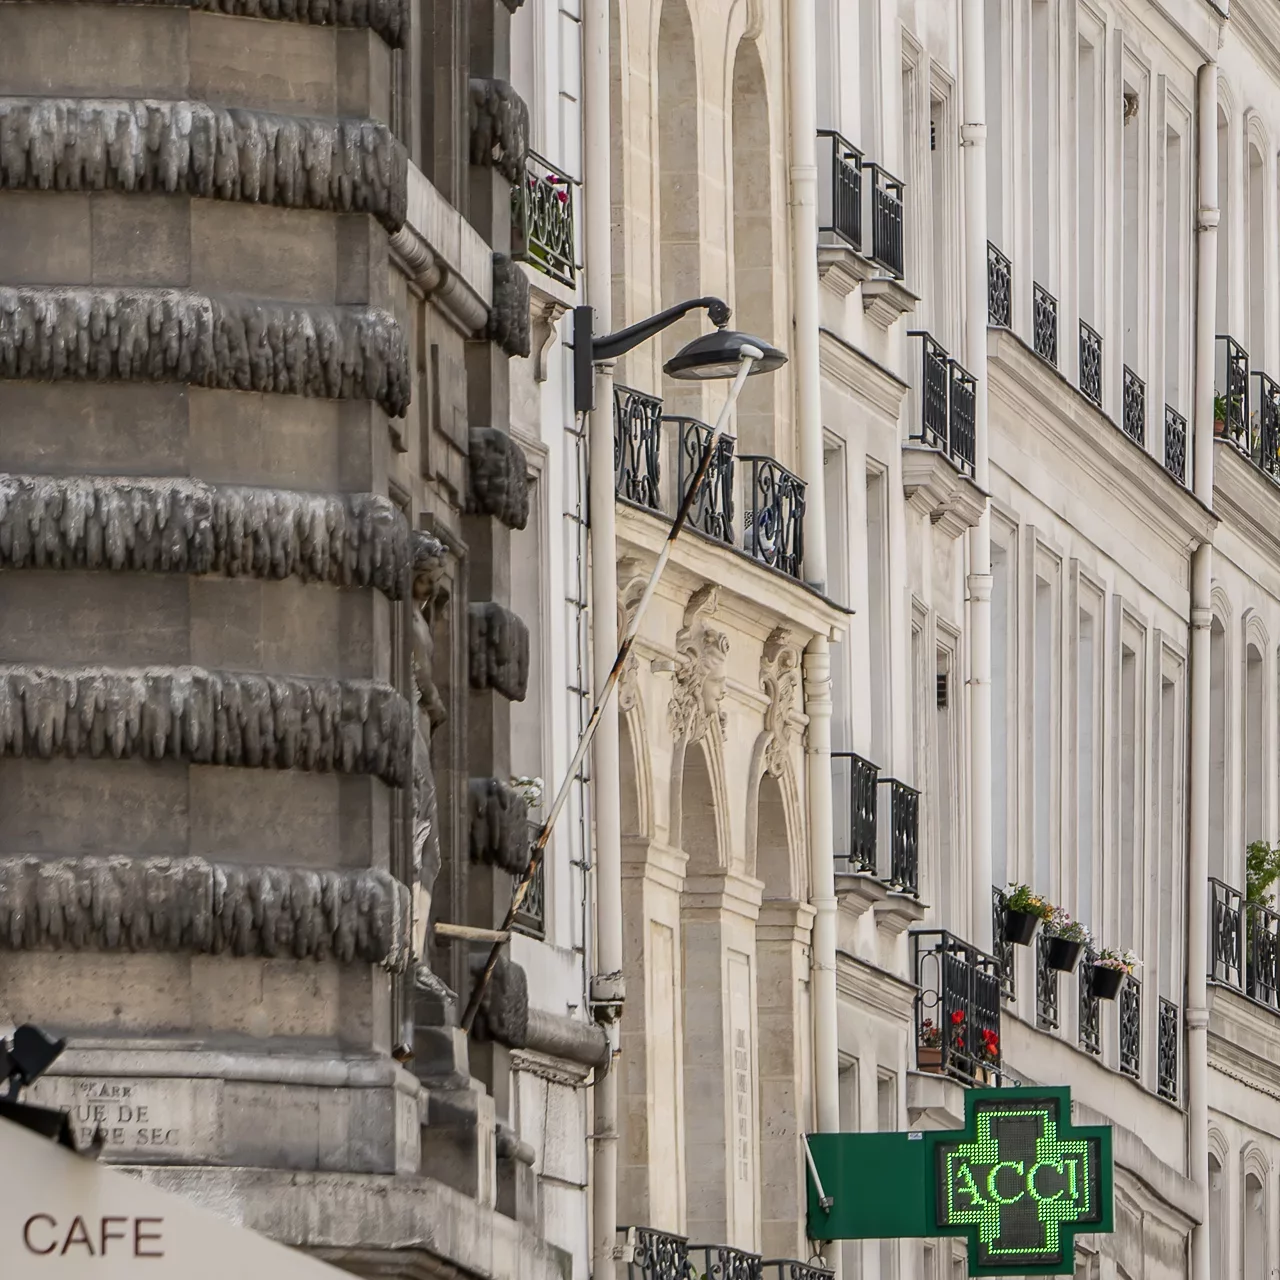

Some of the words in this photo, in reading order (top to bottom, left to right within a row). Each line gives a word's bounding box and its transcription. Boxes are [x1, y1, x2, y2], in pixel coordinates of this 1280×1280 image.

[118, 1106, 149, 1123] DE
[136, 1128, 180, 1146] SEC
[22, 1213, 165, 1258] CAFE
